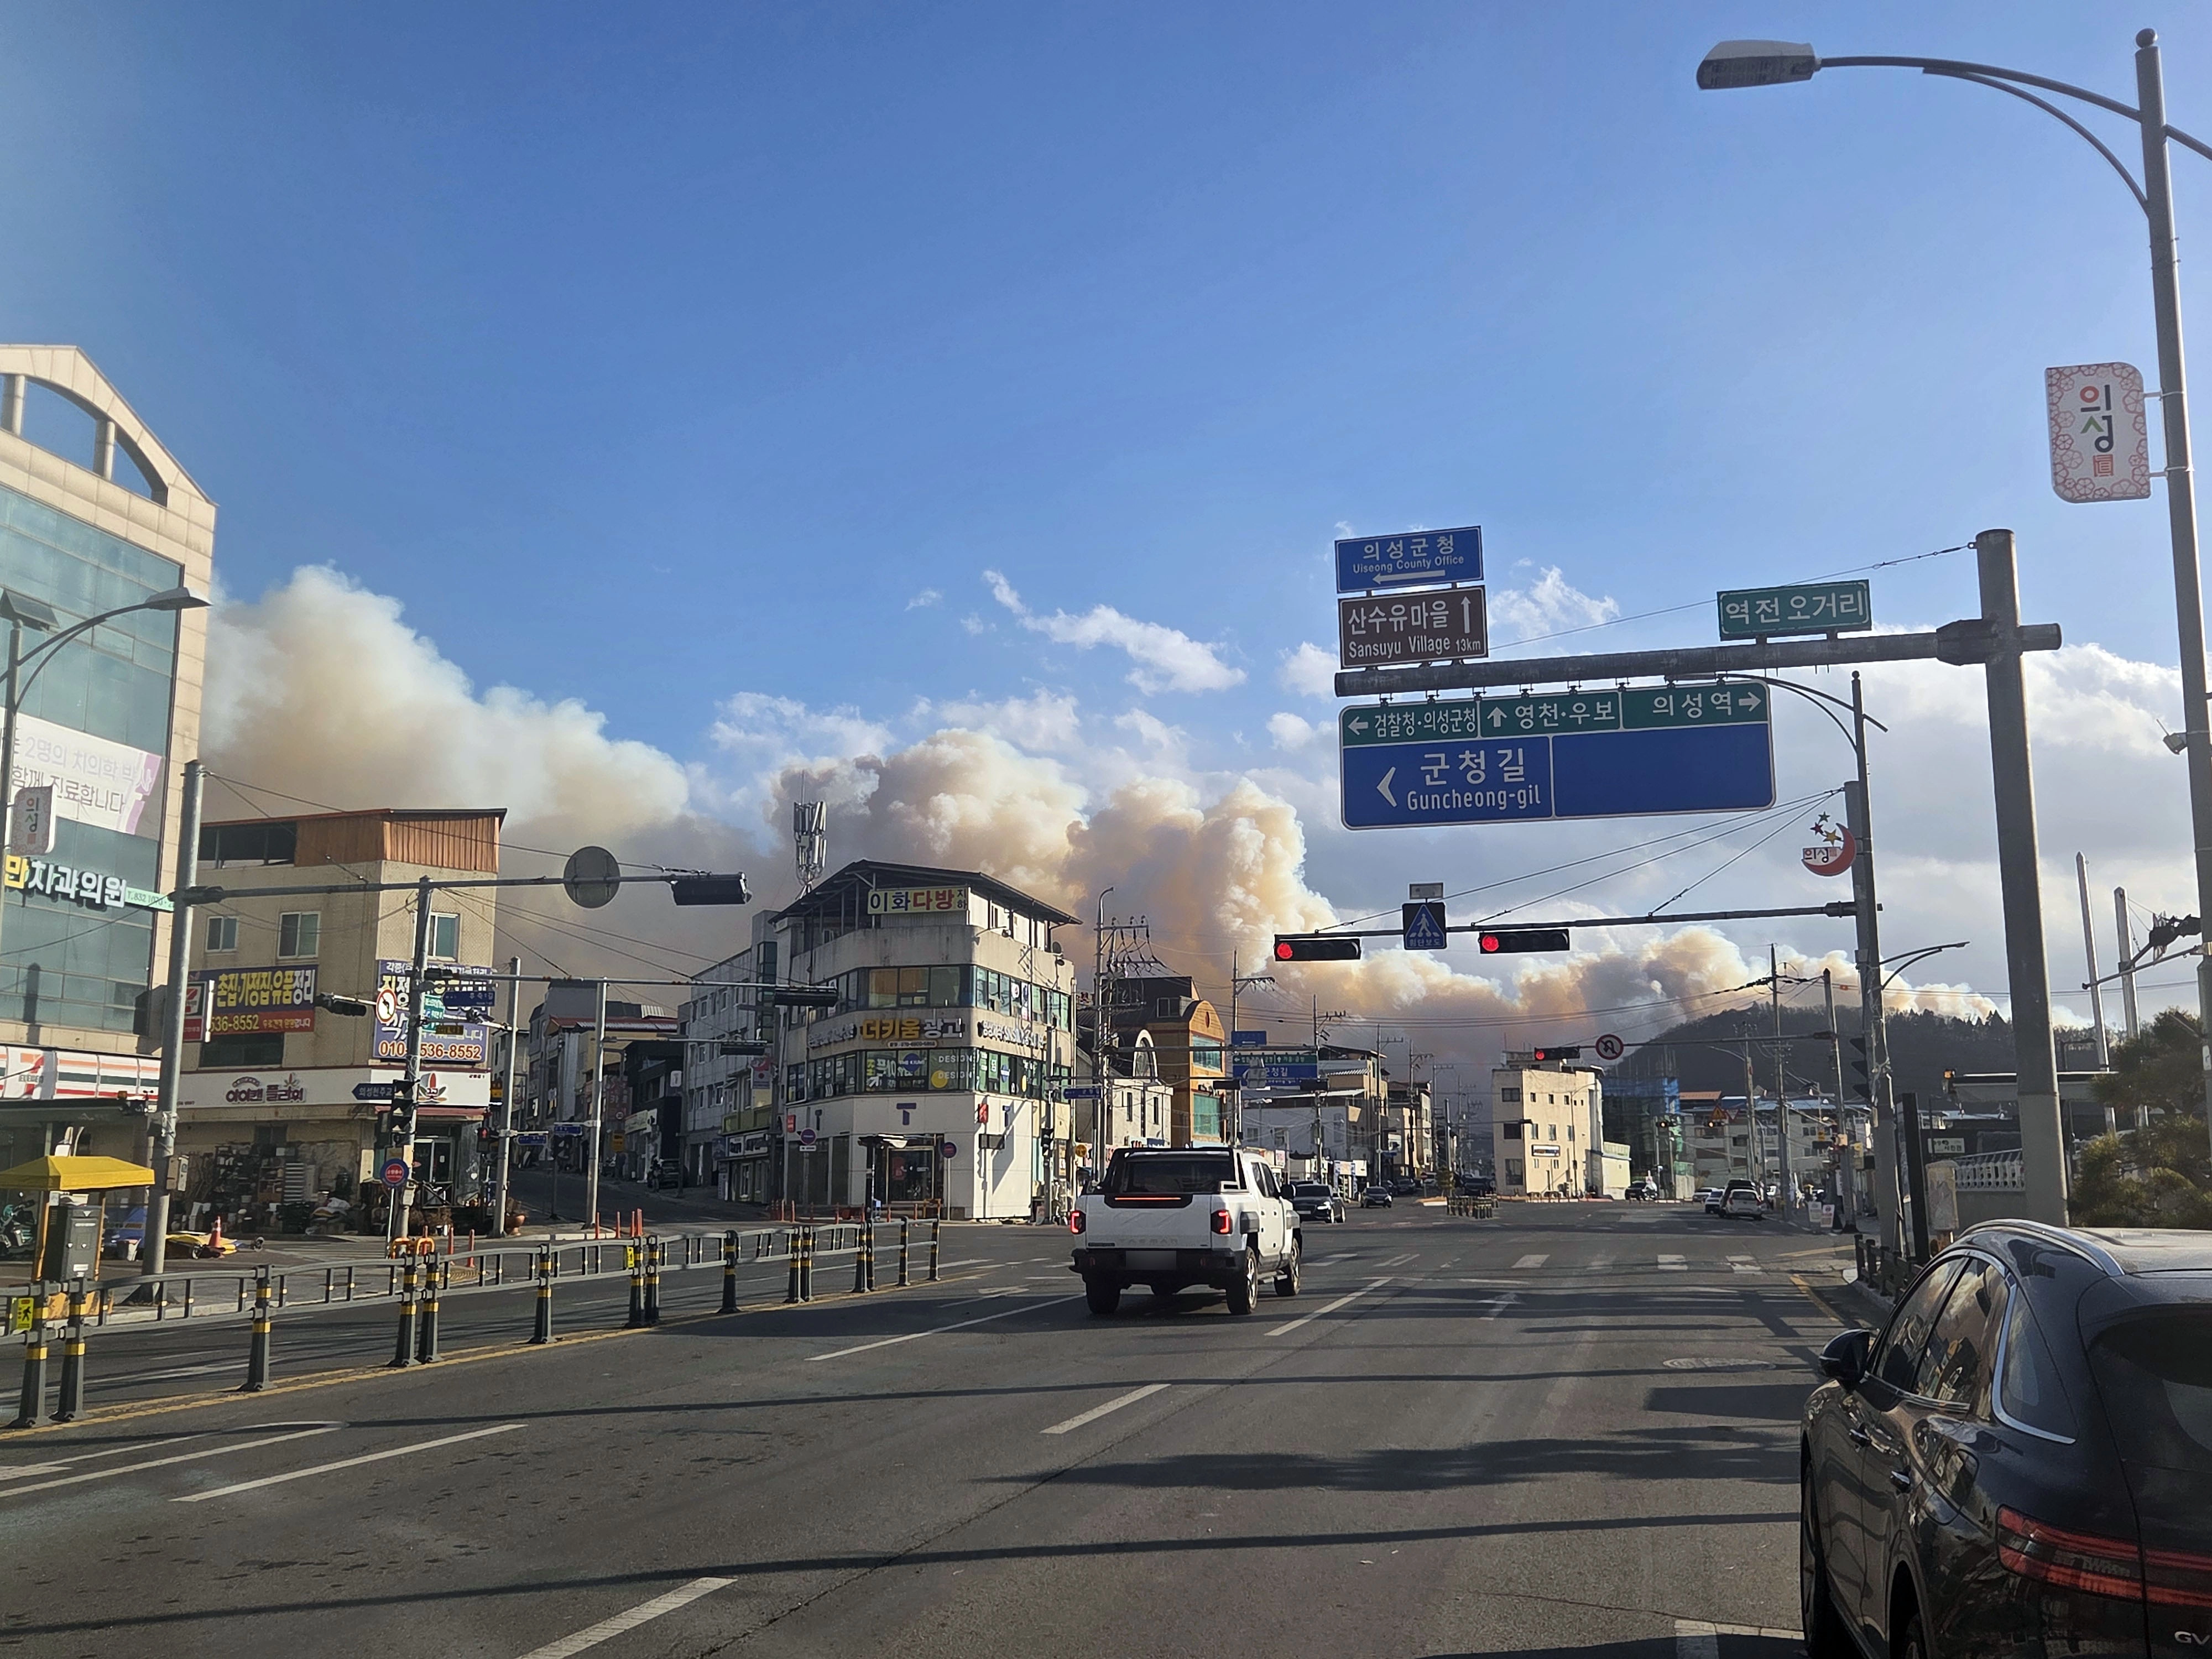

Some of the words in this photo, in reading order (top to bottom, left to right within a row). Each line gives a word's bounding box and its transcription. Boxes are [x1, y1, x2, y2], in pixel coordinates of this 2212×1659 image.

[2079, 384, 2114, 453] 의성
[1363, 534, 1454, 561] 의성군청
[1353, 562, 1392, 573] Uiseong
[1396, 559, 1431, 570] County
[1434, 555, 1464, 566] Office
[1348, 601, 1449, 635] 산수유마을
[1349, 641, 1401, 659] Sansuyu
[1408, 635, 1451, 655] Village
[1455, 639, 1481, 653] 13km
[1652, 691, 1732, 718] 의성역
[72, 749, 118, 780] 치의학
[1420, 748, 1525, 785] 군청길
[1407, 784, 1541, 810] Guncheong-gil
[870, 889, 954, 912] 이화다방
[938, 1055, 972, 1063] DESIGN
